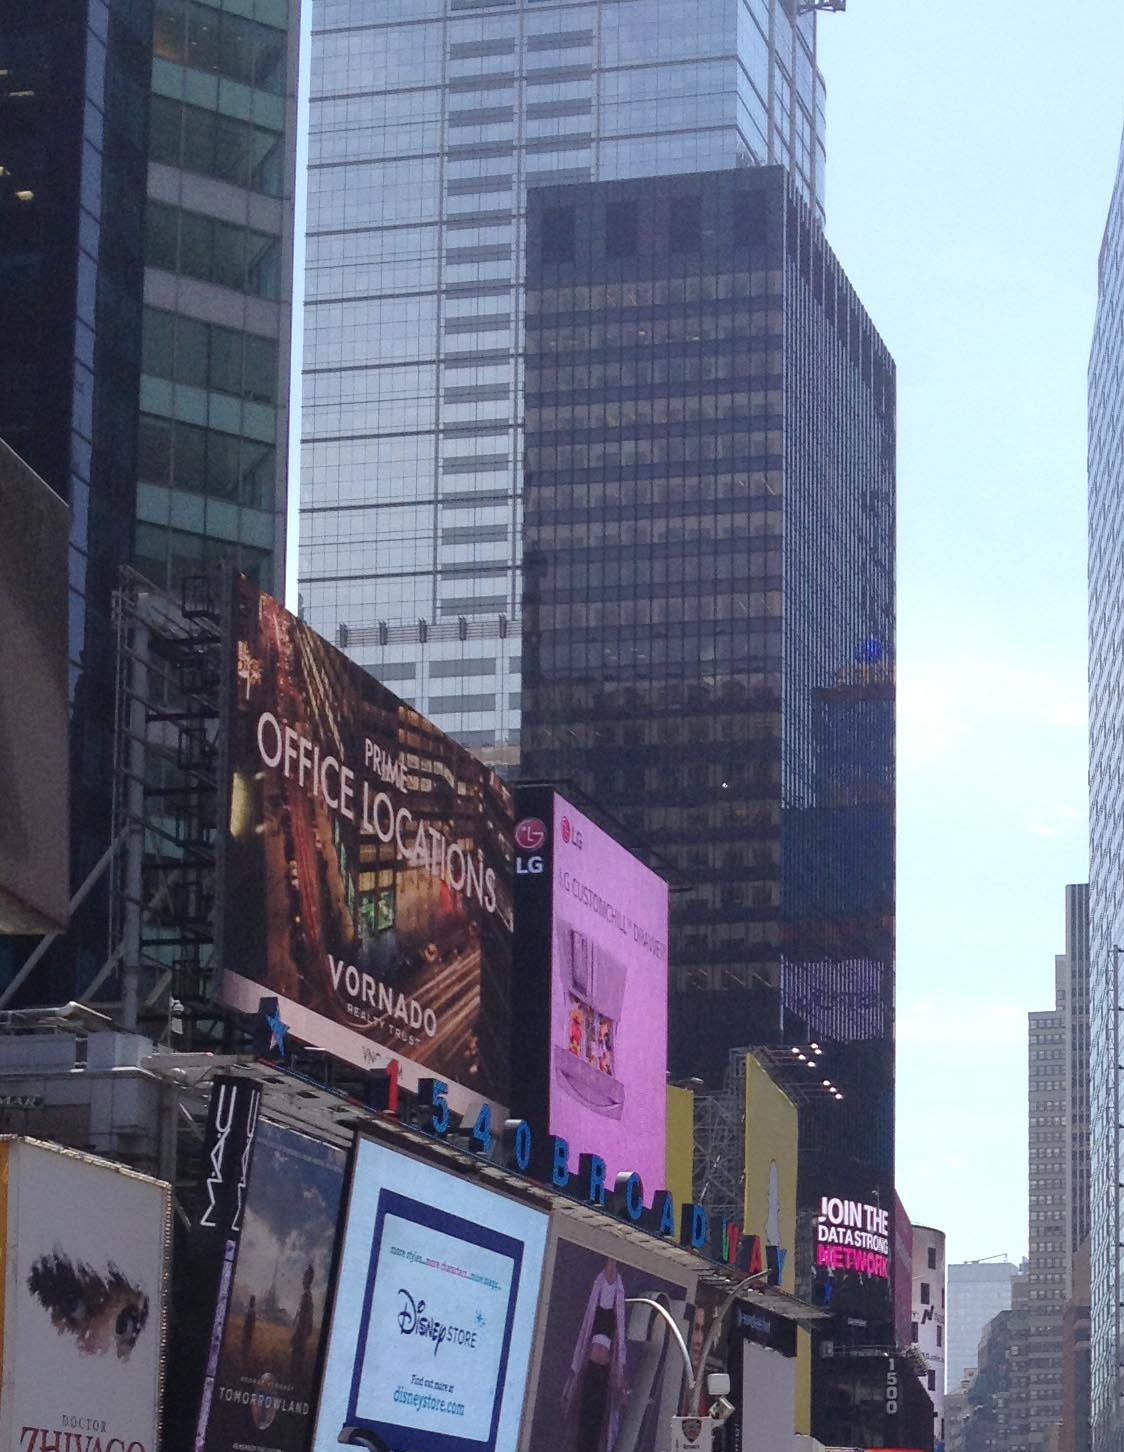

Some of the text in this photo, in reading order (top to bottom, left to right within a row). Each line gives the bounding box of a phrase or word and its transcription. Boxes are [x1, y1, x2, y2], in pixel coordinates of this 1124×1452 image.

[364, 737, 408, 794] PRIME
[257, 711, 497, 913] OFFICE LOCATIONS
[571, 827, 584, 850] LG
[515, 856, 544, 874] LG
[327, 953, 438, 1038] VORNADO
[386, 1059, 788, 1288] 1540 BROADWAY
[818, 1197, 889, 1236] JOIN THE
[817, 1243, 889, 1279] NETWORK
[398, 1288, 477, 1358] Disney STORE
[219, 1386, 310, 1416] TOMORROWLAND
[393, 1385, 465, 1417] disneystore.com
[886, 1358, 898, 1415] 1500
[61, 1414, 107, 1433] DOCTOR
